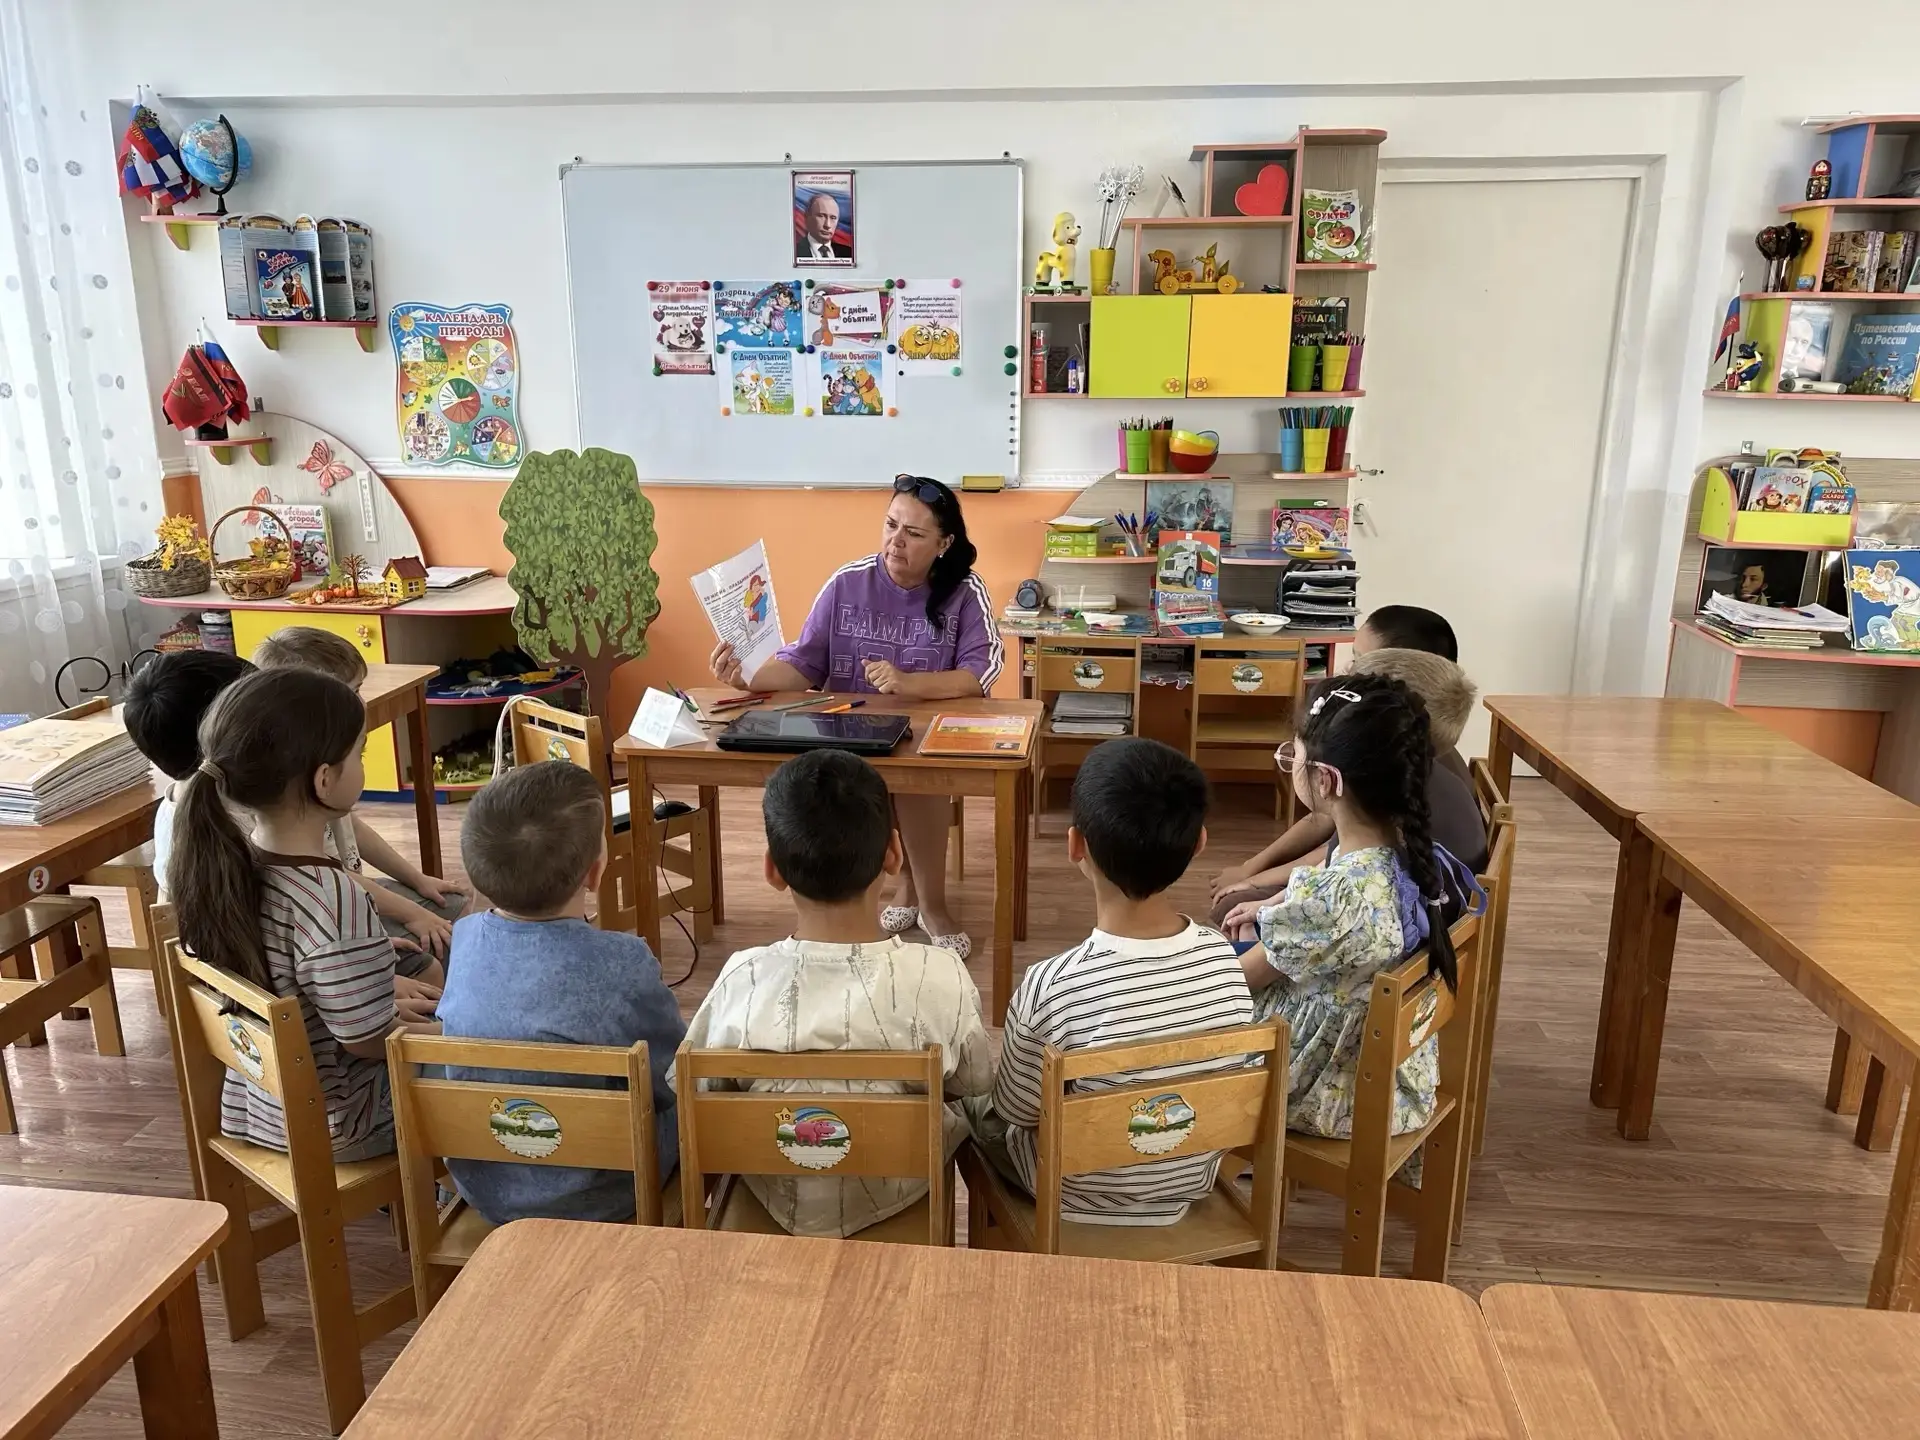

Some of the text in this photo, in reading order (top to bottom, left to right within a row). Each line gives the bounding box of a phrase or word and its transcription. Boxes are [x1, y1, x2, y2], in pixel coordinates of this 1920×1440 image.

[1307, 209, 1350, 220] ФРУКТЫ
[658, 285, 670, 293] 29
[1293, 298, 1322, 307] ИСУЕМ
[848, 306, 869, 315] днём
[425, 312, 504, 324] КАЛЕНДАРЬ
[842, 315, 877, 324] объятий!
[1293, 313, 1337, 323] БУМАГА
[440, 326, 504, 338] ПРИРОДЫ
[1853, 322, 1920, 336] Путешествие
[1861, 334, 1908, 346] по России
[733, 352, 738, 360] С
[822, 351, 828, 360] С
[1201, 578, 1213, 588] 16
[34, 869, 44, 890] 3
[493, 1103, 501, 1111] 9
[780, 1113, 791, 1121] 19
